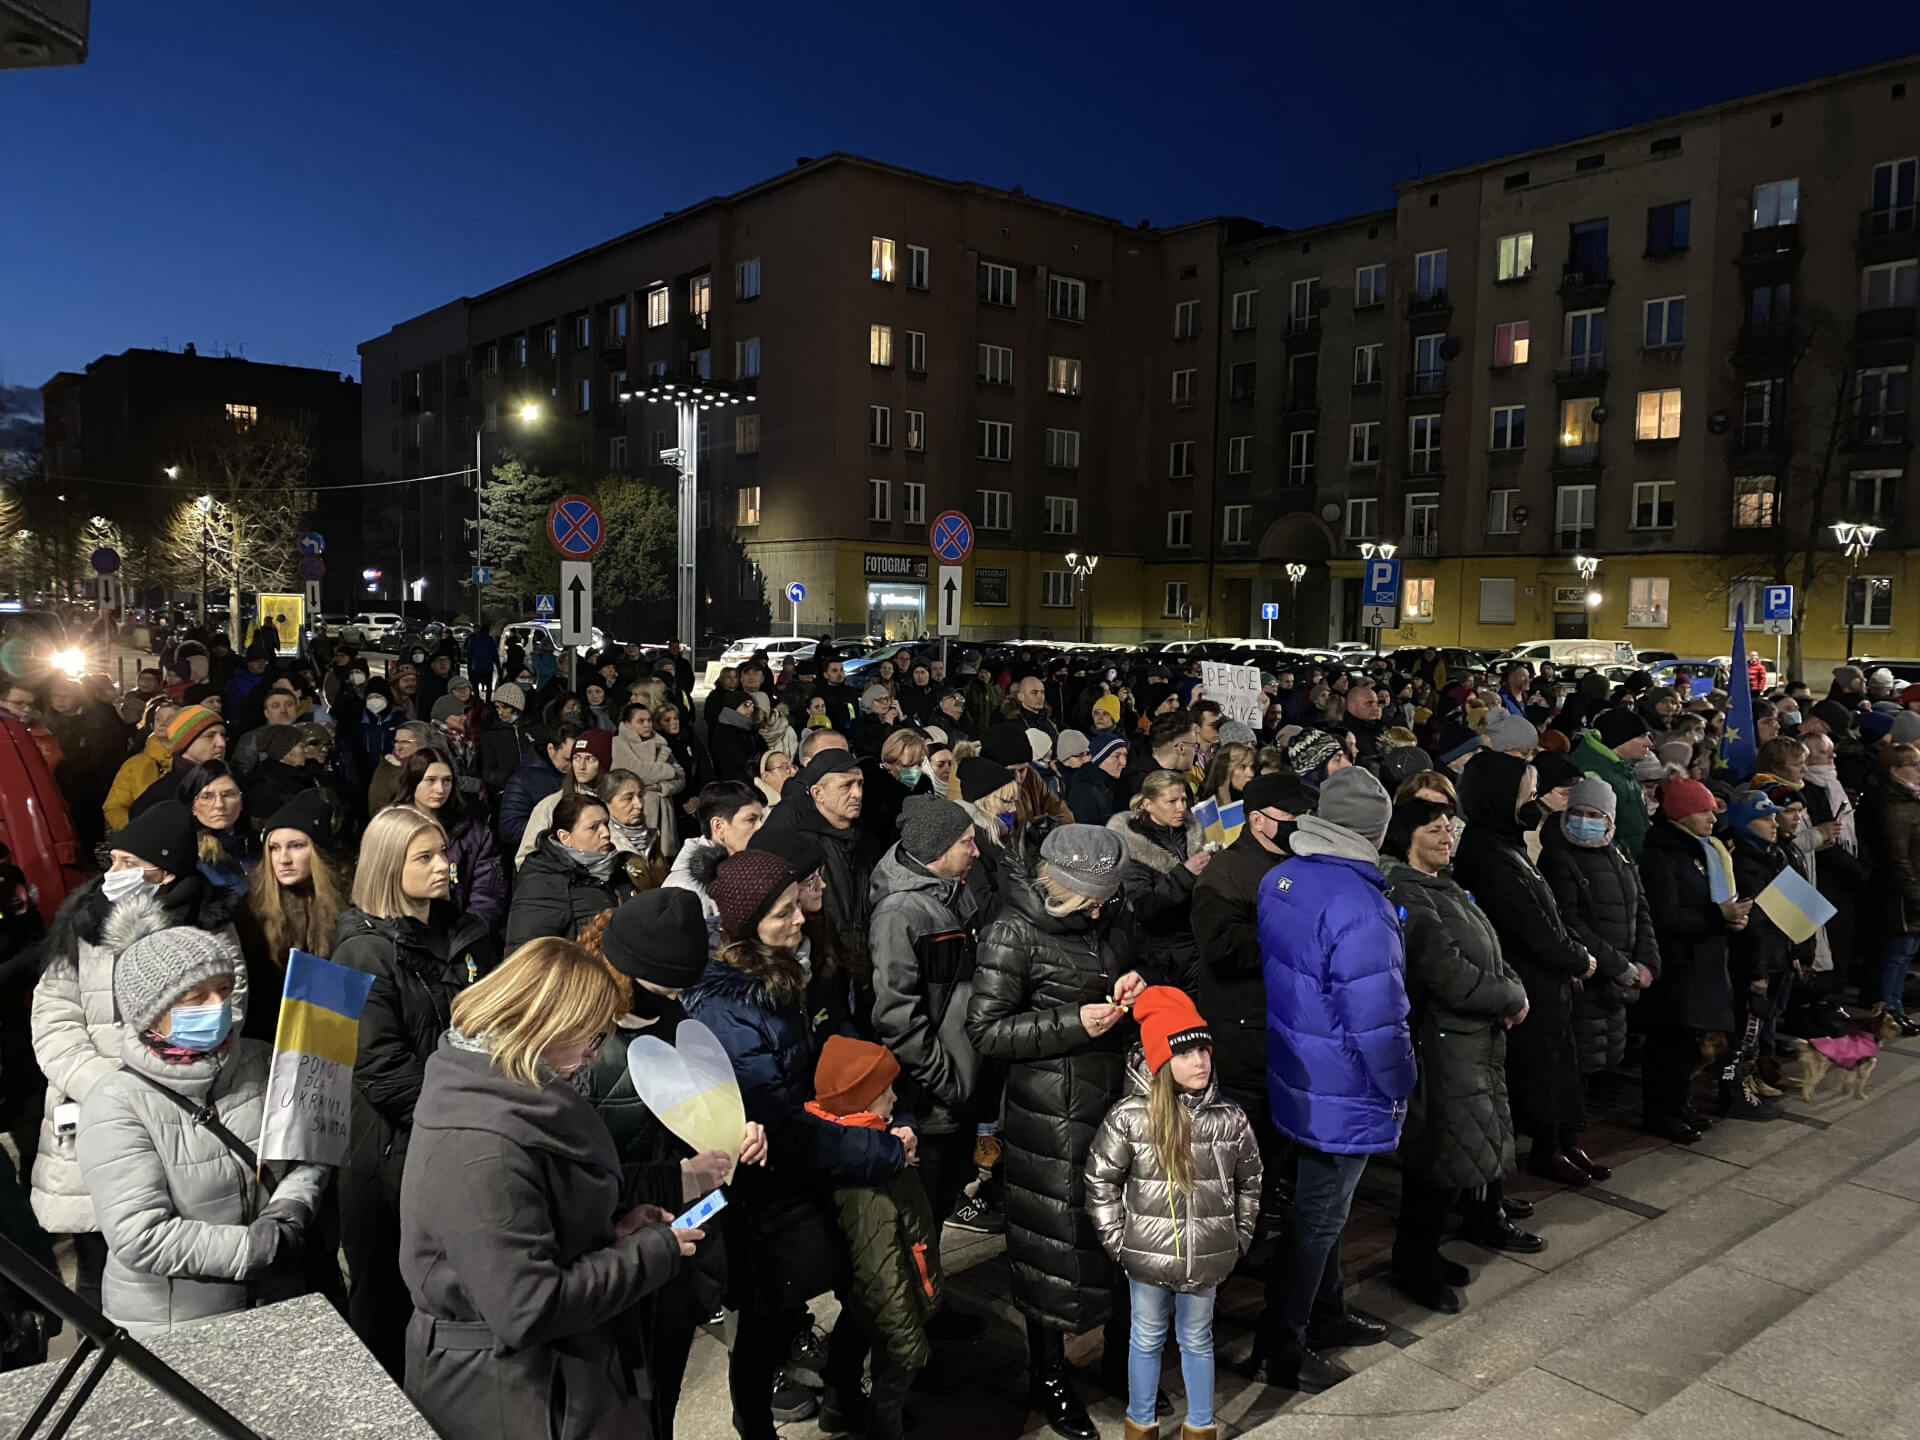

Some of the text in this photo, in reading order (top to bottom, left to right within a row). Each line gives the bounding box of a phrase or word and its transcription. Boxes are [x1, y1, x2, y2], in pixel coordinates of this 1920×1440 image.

[865, 556, 912, 574] FOTOGRAF
[1371, 562, 1392, 592] P
[1770, 589, 1786, 610] P
[1207, 667, 1257, 690] PEACE
